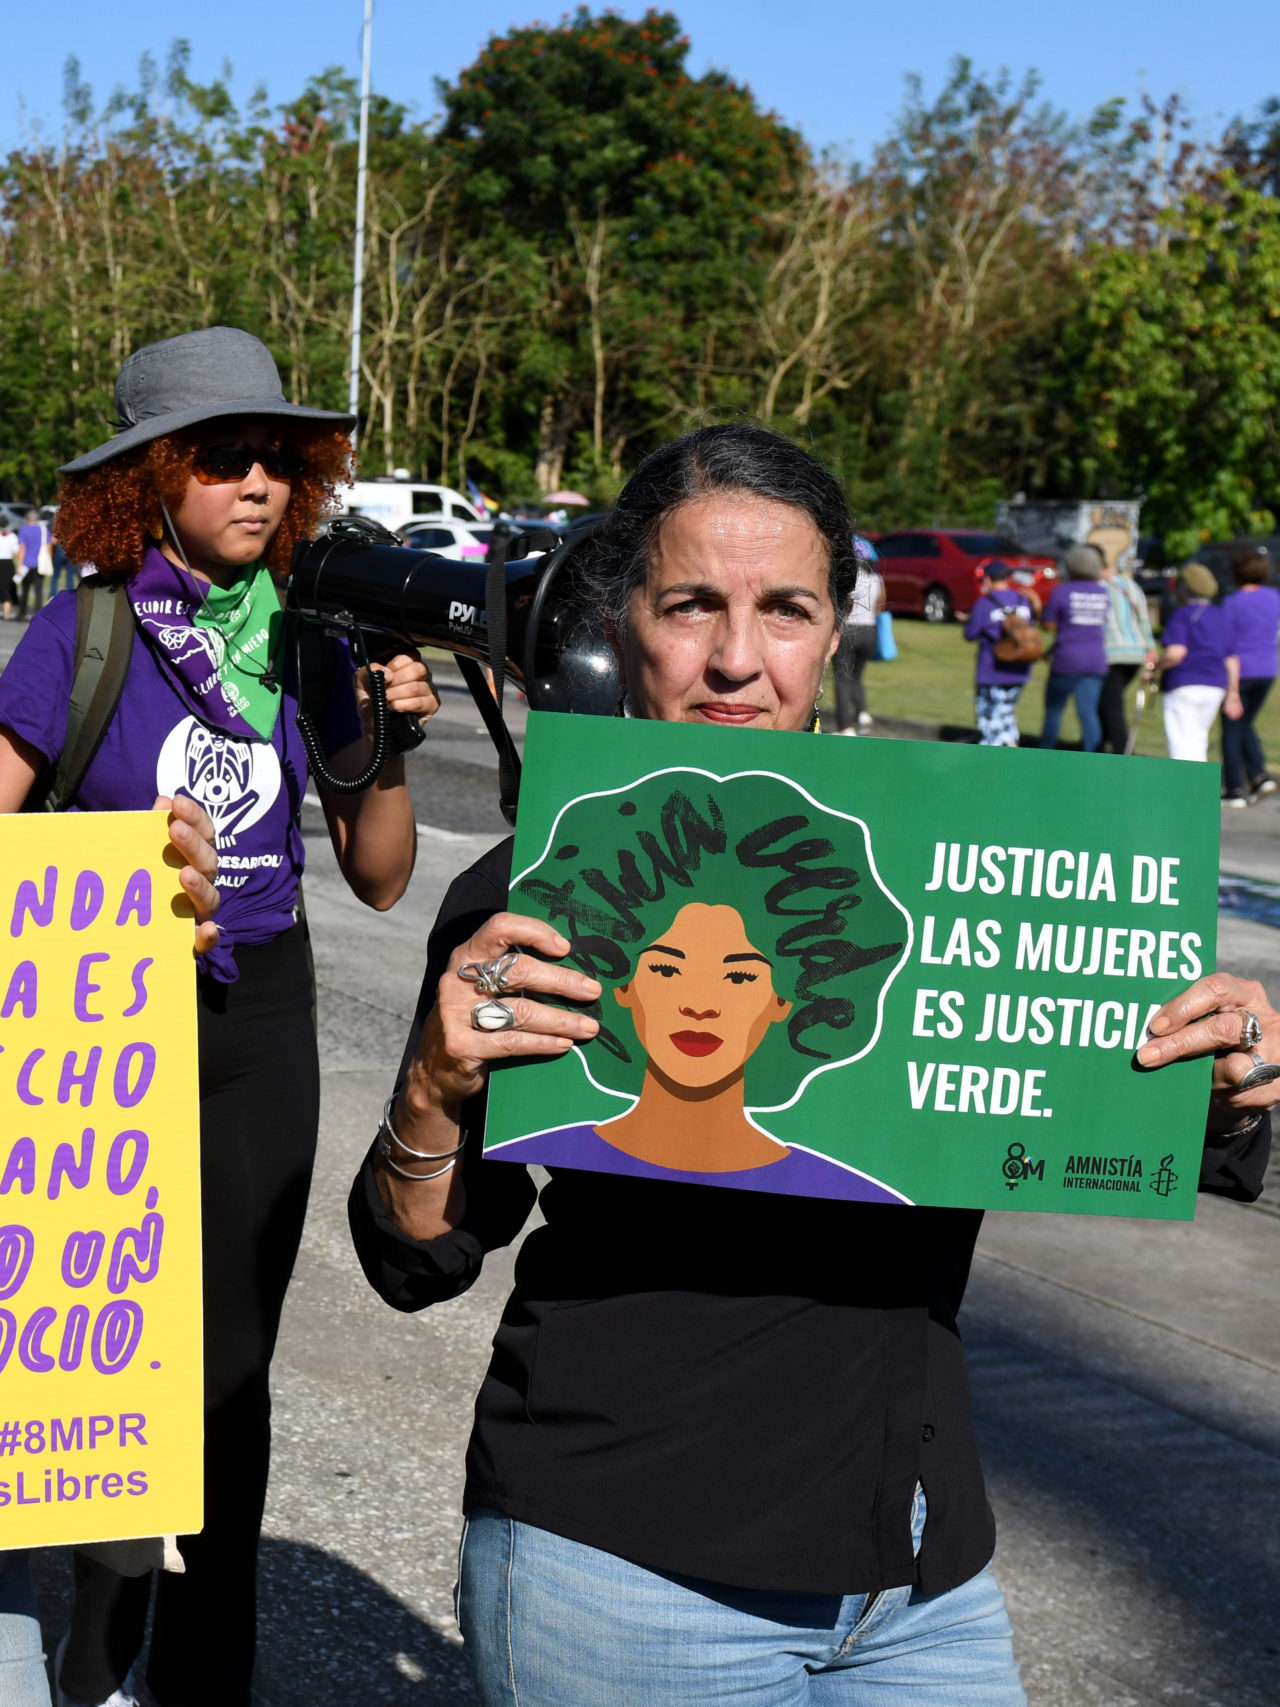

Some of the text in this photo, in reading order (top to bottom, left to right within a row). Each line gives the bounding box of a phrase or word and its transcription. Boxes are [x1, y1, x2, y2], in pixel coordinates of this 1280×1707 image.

[133, 599, 172, 617] ECIDIR
[924, 841, 1181, 906] JUSTICIA DE
[919, 916, 1203, 984] LAS MUJERES
[73, 952, 155, 1024] ES
[911, 989, 964, 1040] ES
[906, 1060, 1055, 1120] VERDE.
[1063, 1176, 1142, 1193] INTERNACIONAL
[1065, 1154, 1143, 1178] AMNISTÍA
[60, 1211, 165, 1296] UN
